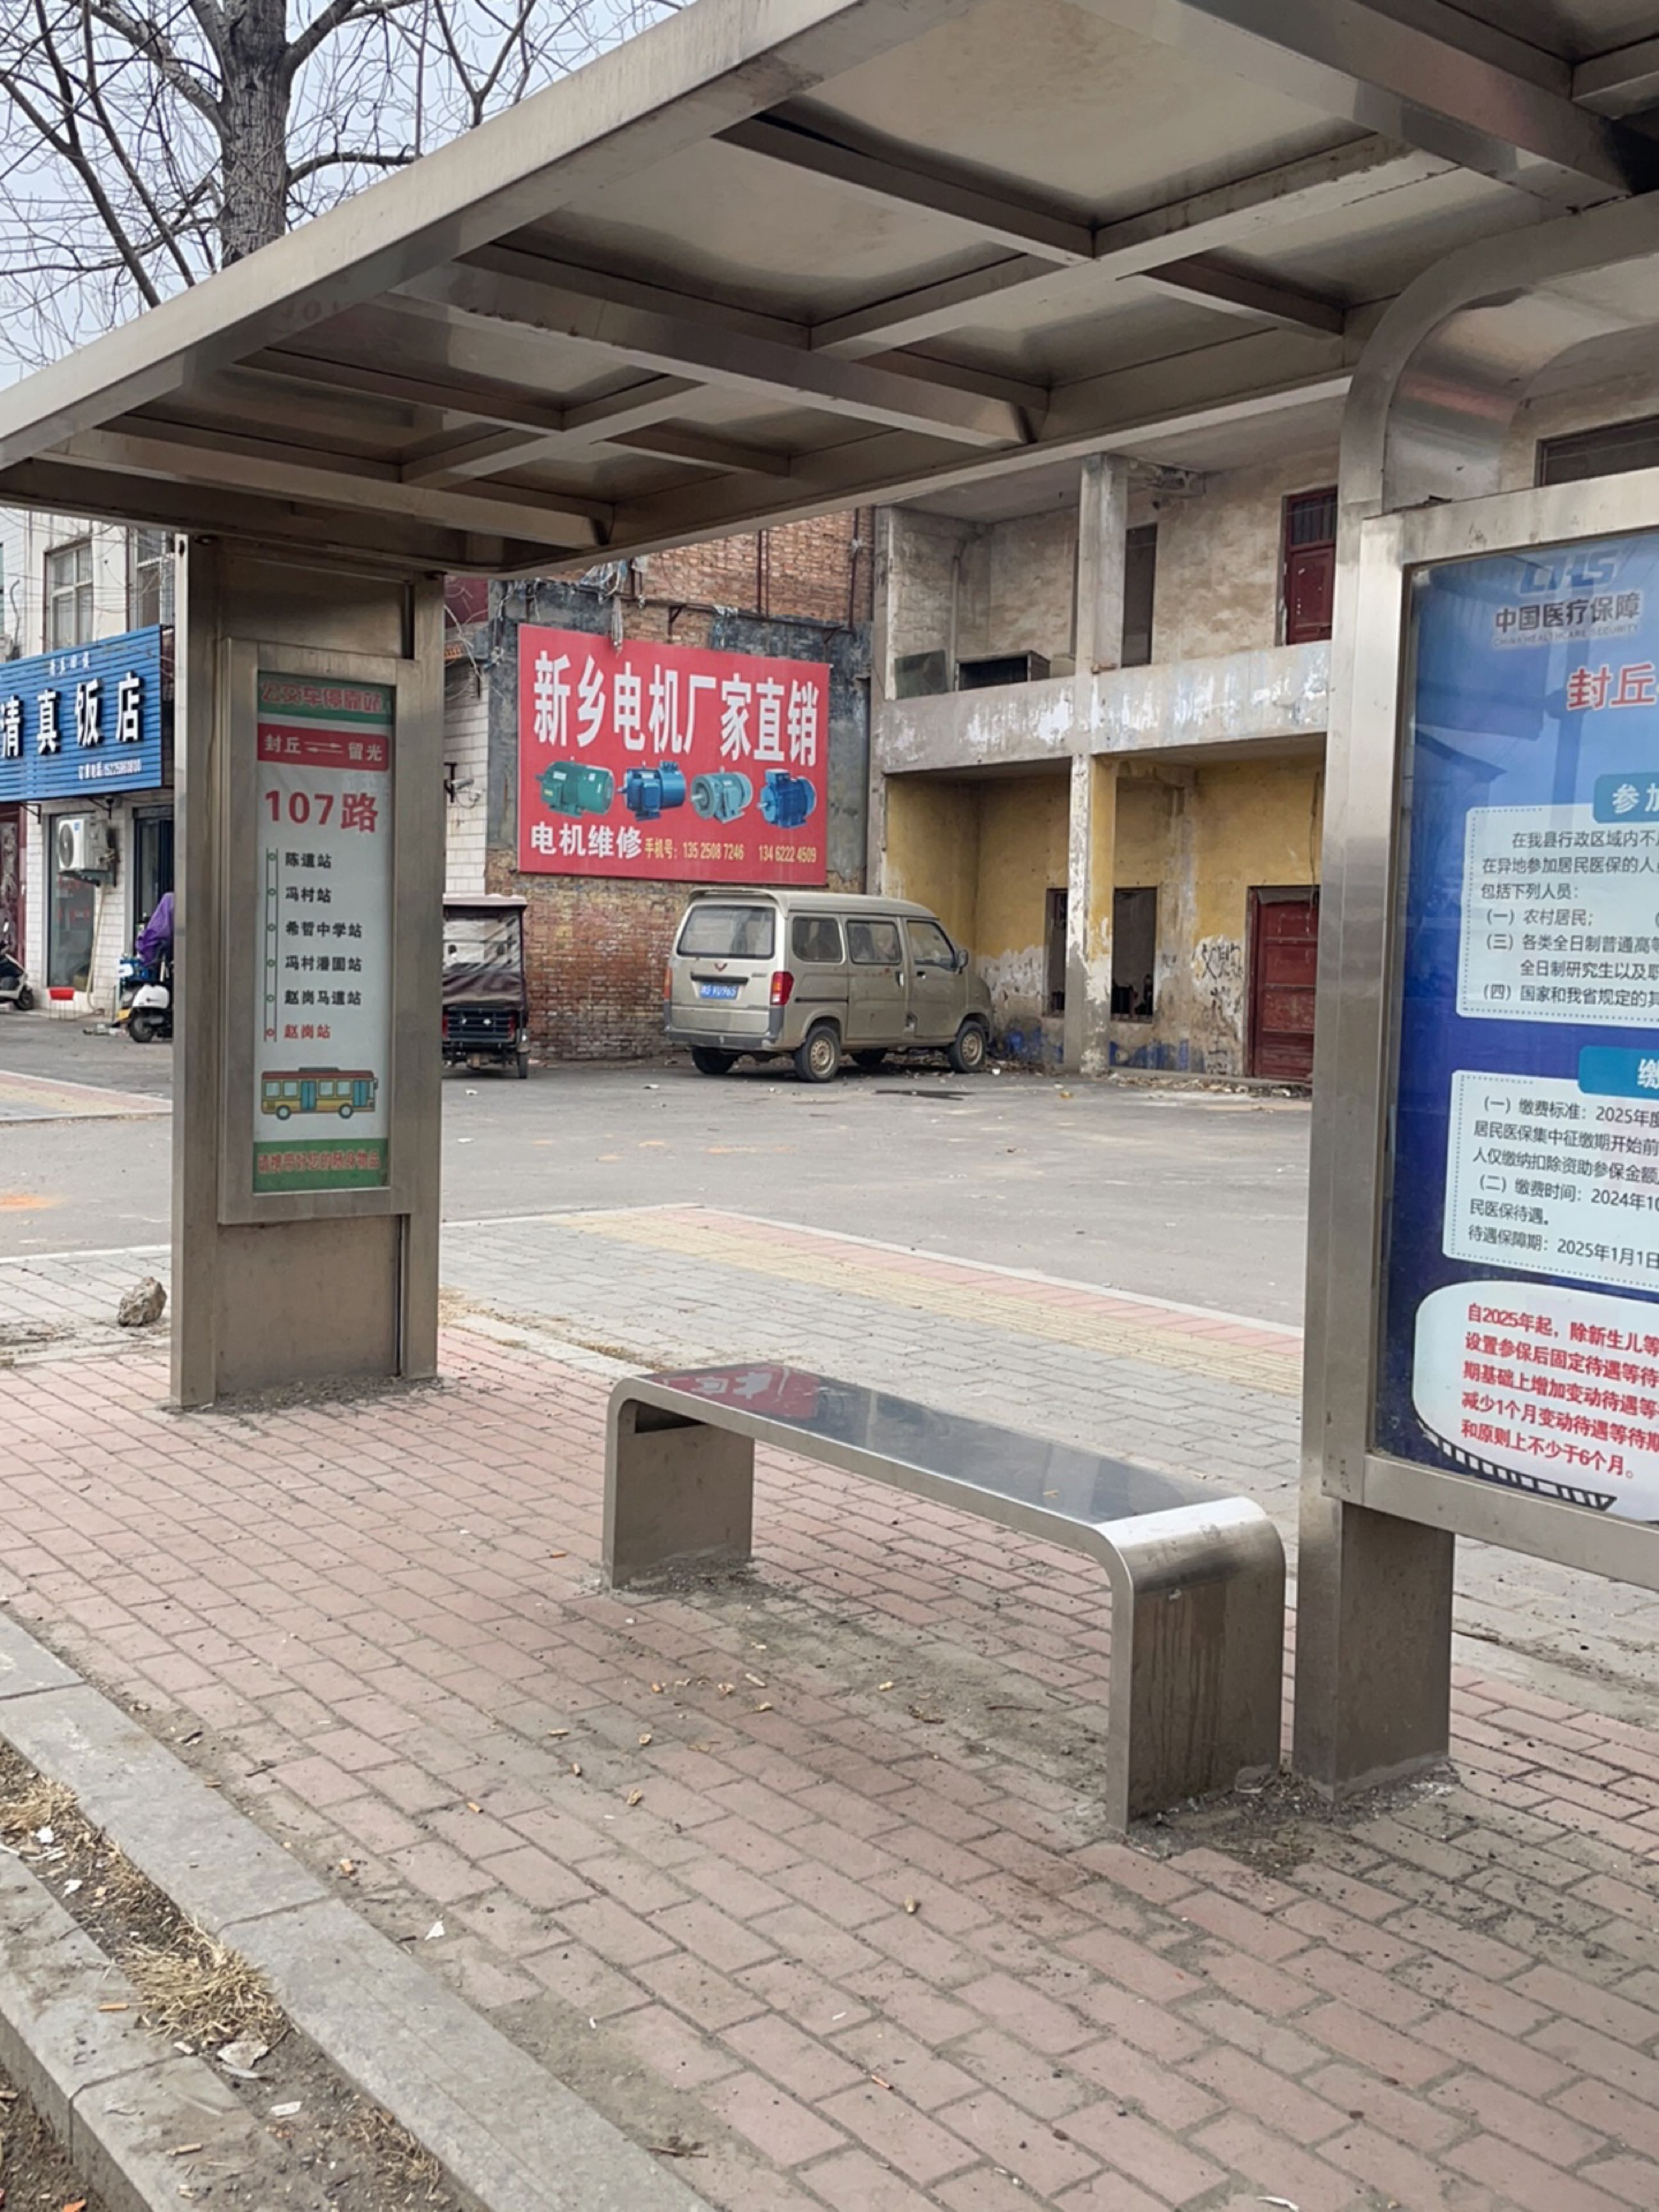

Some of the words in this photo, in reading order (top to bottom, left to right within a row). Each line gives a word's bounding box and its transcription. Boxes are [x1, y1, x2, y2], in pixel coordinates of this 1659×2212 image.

[1496, 592, 1640, 634] 中国医疗保障
[1567, 663, 1655, 709] 封丘
[533, 650, 820, 767] 新乡电机厂家直销
[264, 734, 301, 755] 封丘
[349, 742, 382, 761] 留光
[265, 789, 378, 833] 107路
[531, 821, 641, 859] 电机维修
[682, 842, 698, 859] 135
[758, 846, 774, 862] 134
[1512, 830, 1659, 849] 在我县行政区域内不
[1482, 856, 1659, 874] 在异地参加居民医保的人
[285, 886, 332, 903] 冯村站
[1480, 883, 1578, 900] 包括下列人员：
[285, 921, 363, 938] 希哲中学站
[284, 991, 362, 1006] 赵岗马道站
[284, 1025, 331, 1039] 赵岗站
[1474, 1119, 1659, 1157] 居民医保集中征缴期开始前
[1464, 1331, 1659, 1388] 设置参保后固定待遇等待
[1461, 1419, 1634, 1479] 和原则上不少于6个月。
